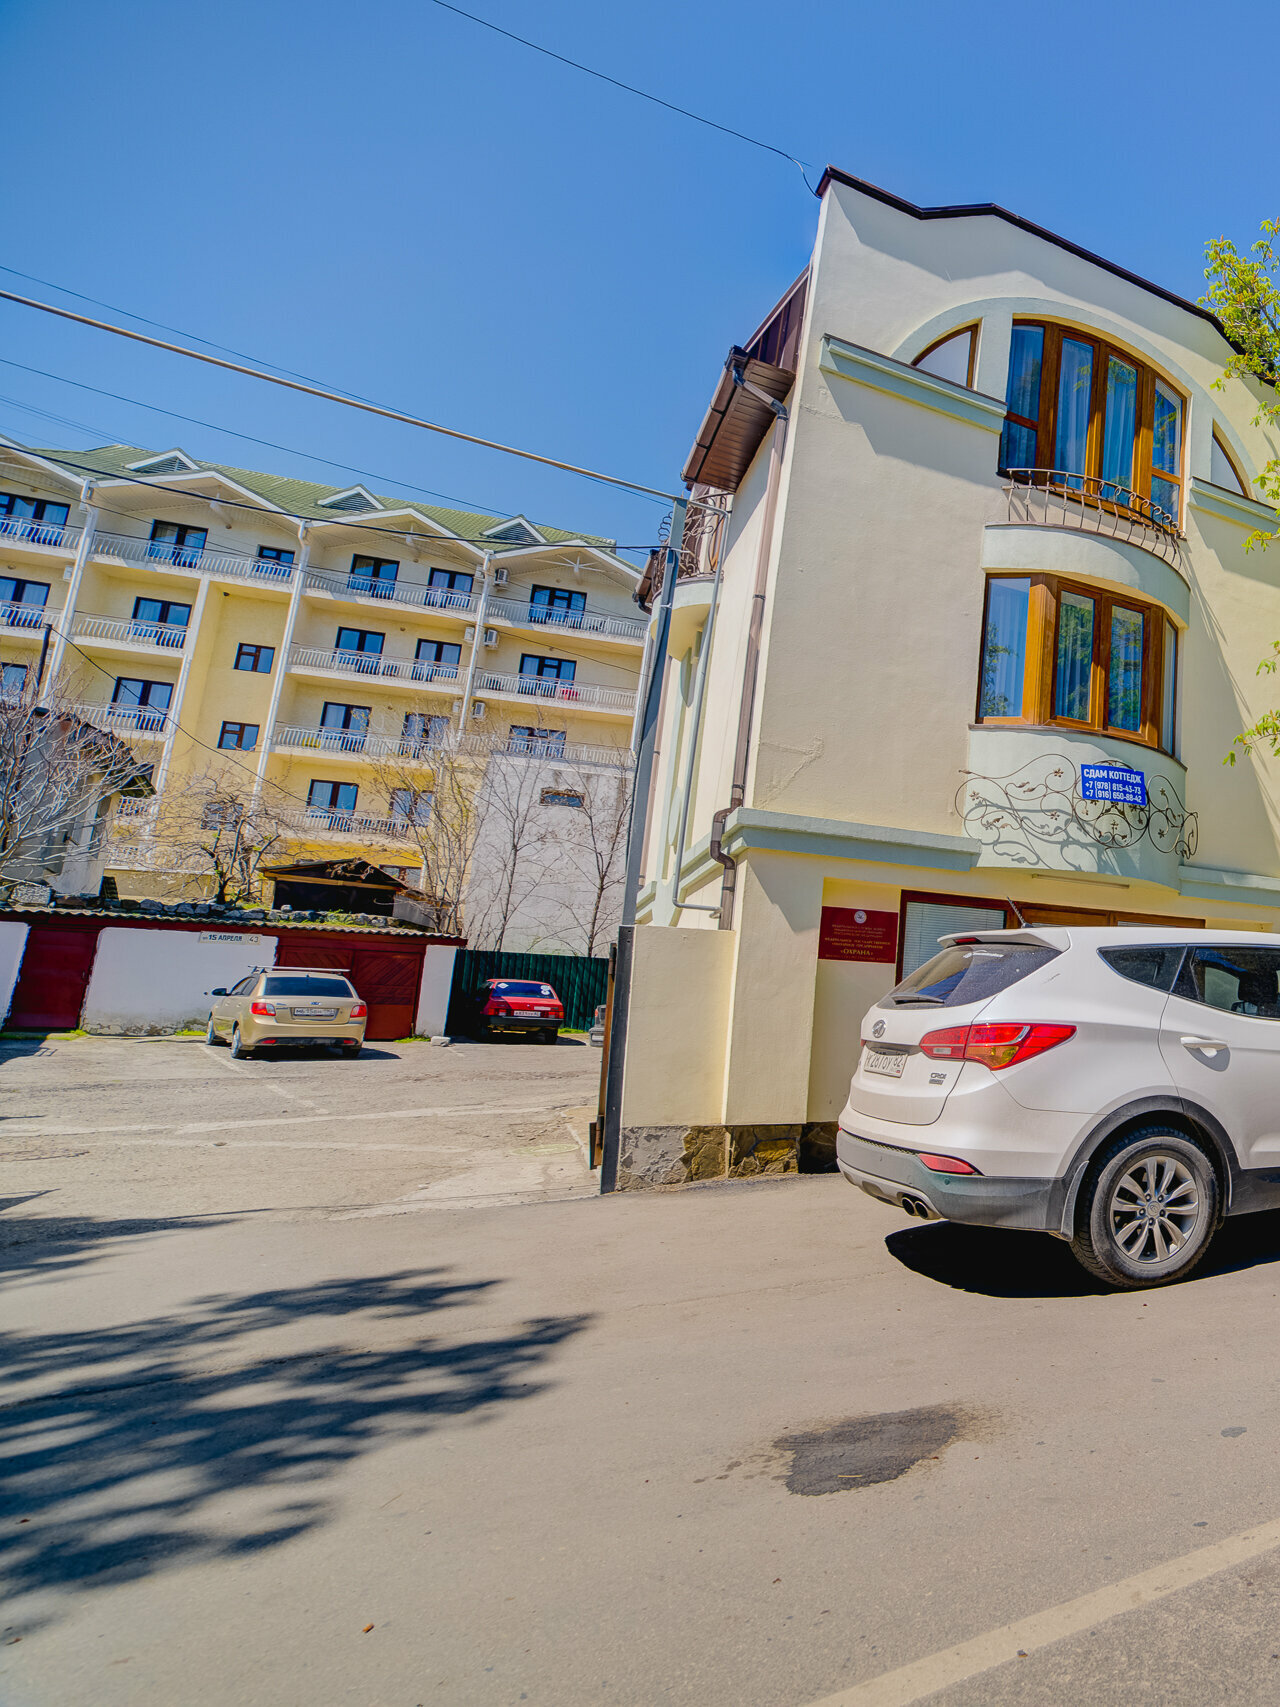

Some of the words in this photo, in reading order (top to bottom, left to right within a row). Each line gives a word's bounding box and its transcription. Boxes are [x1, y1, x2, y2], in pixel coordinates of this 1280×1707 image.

[1084, 769, 1107, 779] СДАМ
[1109, 770, 1142, 783] КОТТЕДЖ
[1085, 780, 1093, 788] +7
[1095, 781, 1111, 792] (978)
[1085, 789, 1093, 797] +7
